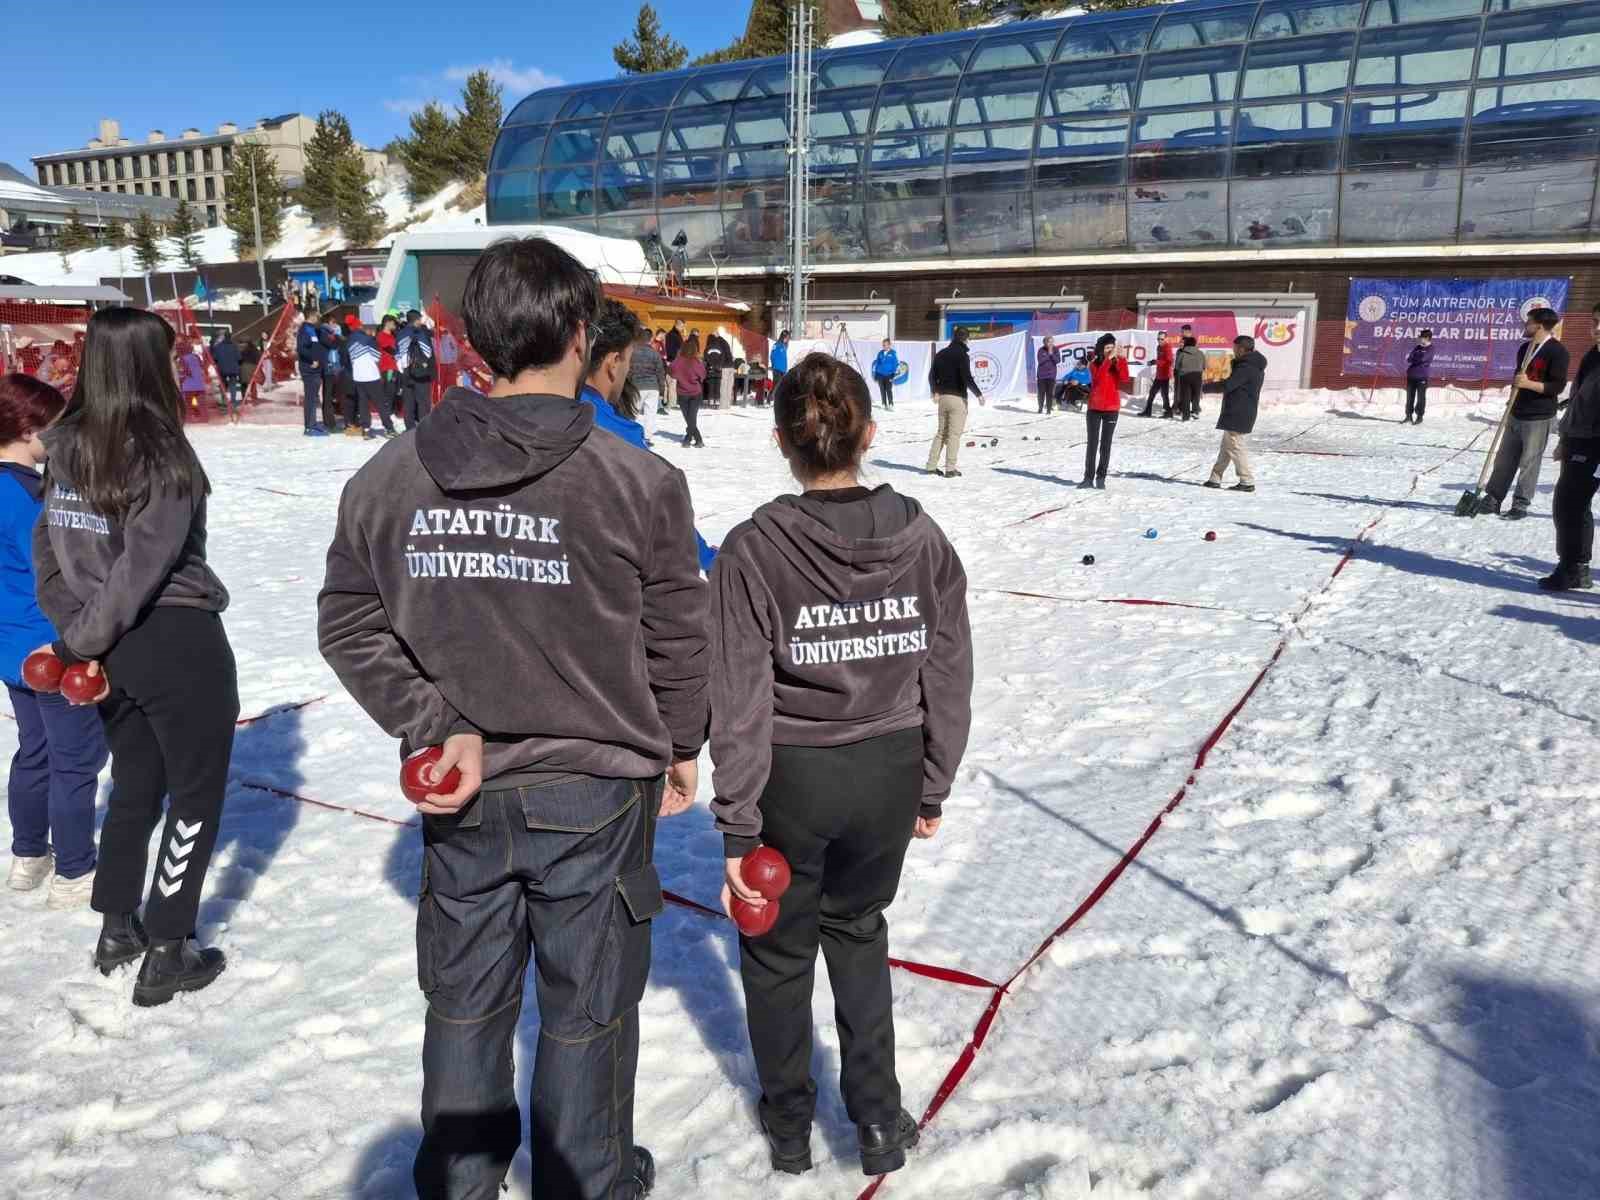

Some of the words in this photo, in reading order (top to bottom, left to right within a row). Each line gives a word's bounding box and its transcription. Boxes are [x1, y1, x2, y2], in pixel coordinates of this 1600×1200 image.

[1392, 295, 1419, 308] TÜM
[1422, 295, 1496, 309] ANTRENÖR
[1499, 297, 1517, 309] VE
[1389, 311, 1514, 325] SPORCULARIMIZA
[1373, 326, 1460, 341] BAŞARLAR
[409, 504, 560, 544] ATATÜRK
[405, 544, 572, 585] ÜNİVERSİTESİ
[789, 624, 928, 665] ÜNİVERSİTESİ
